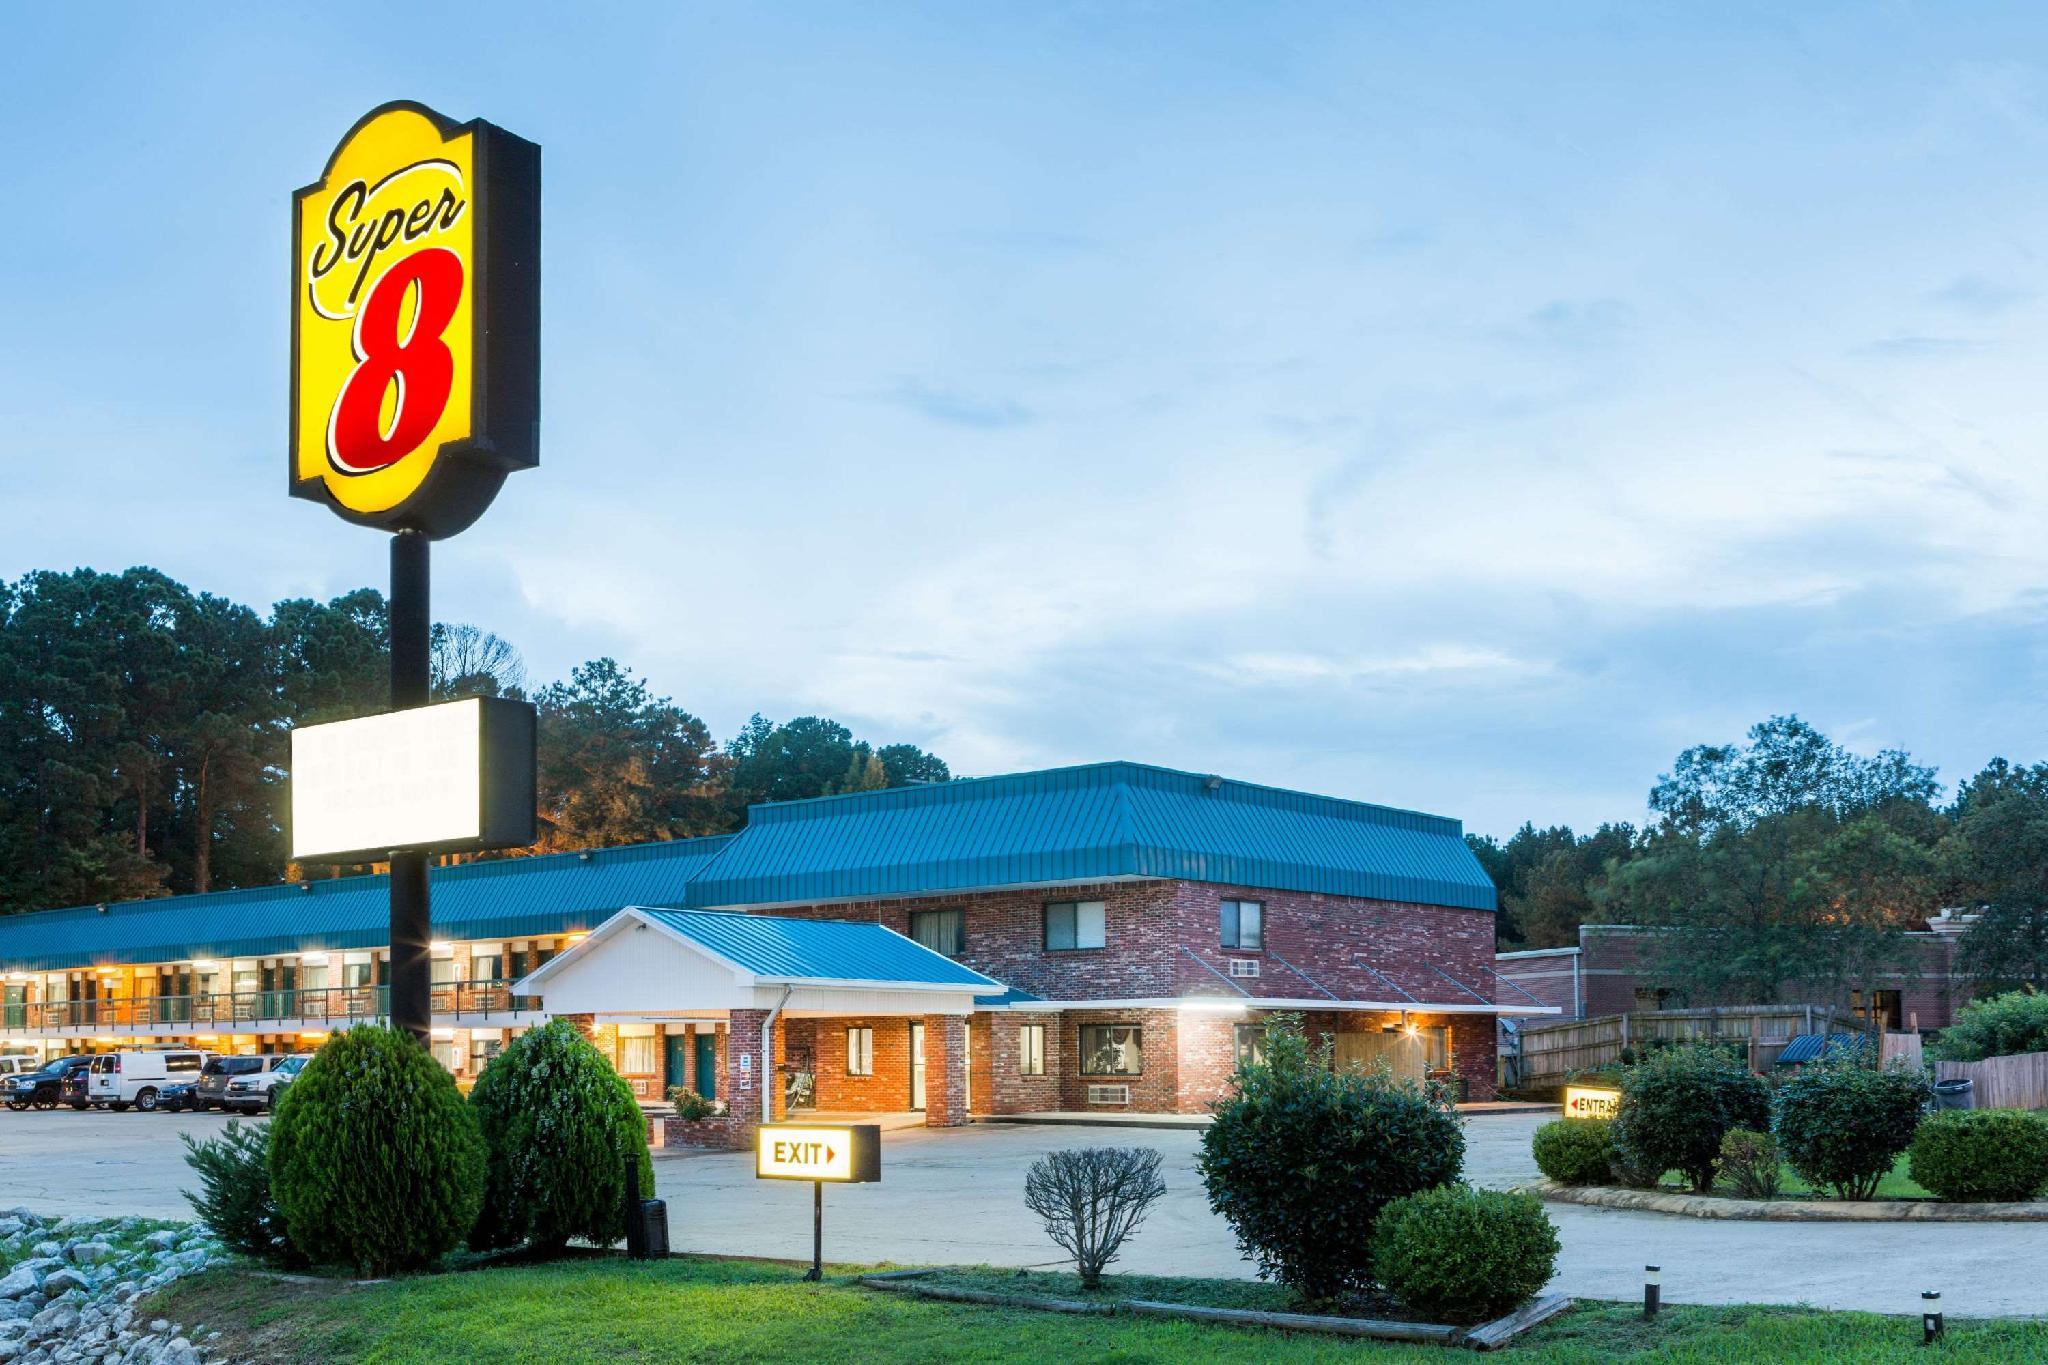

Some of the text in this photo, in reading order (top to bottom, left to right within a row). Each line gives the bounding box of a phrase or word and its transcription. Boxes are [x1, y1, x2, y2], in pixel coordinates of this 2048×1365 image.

[311, 179, 466, 306] Super
[327, 247, 464, 475] 8
[773, 1141, 822, 1165] EXIT
